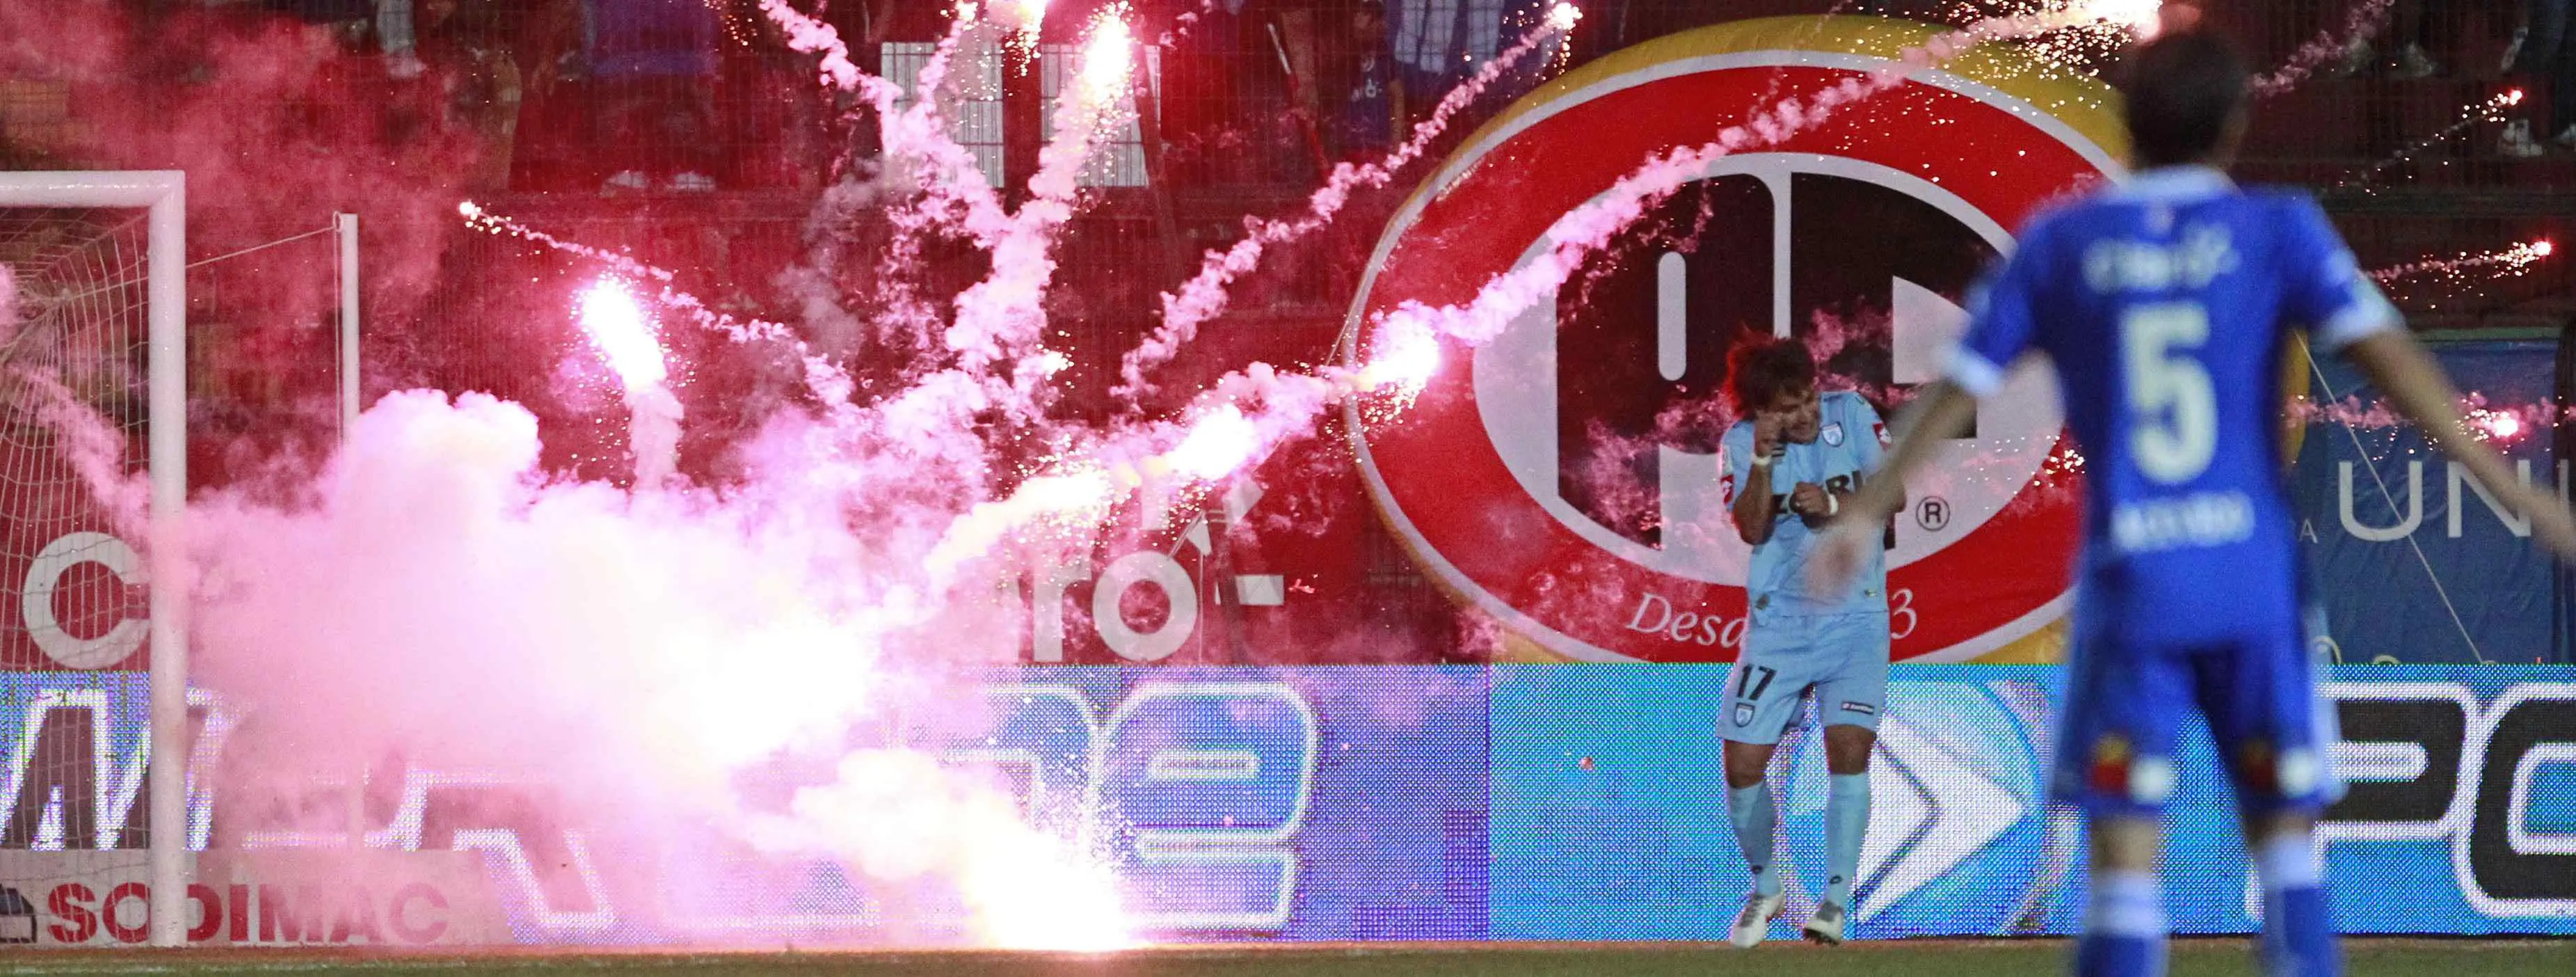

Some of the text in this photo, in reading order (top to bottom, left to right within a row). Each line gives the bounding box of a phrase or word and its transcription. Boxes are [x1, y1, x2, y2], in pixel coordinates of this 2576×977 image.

[2119, 301, 2219, 485] 5
[1738, 664, 1777, 701] 17
[47, 881, 450, 944] SODIMAC
